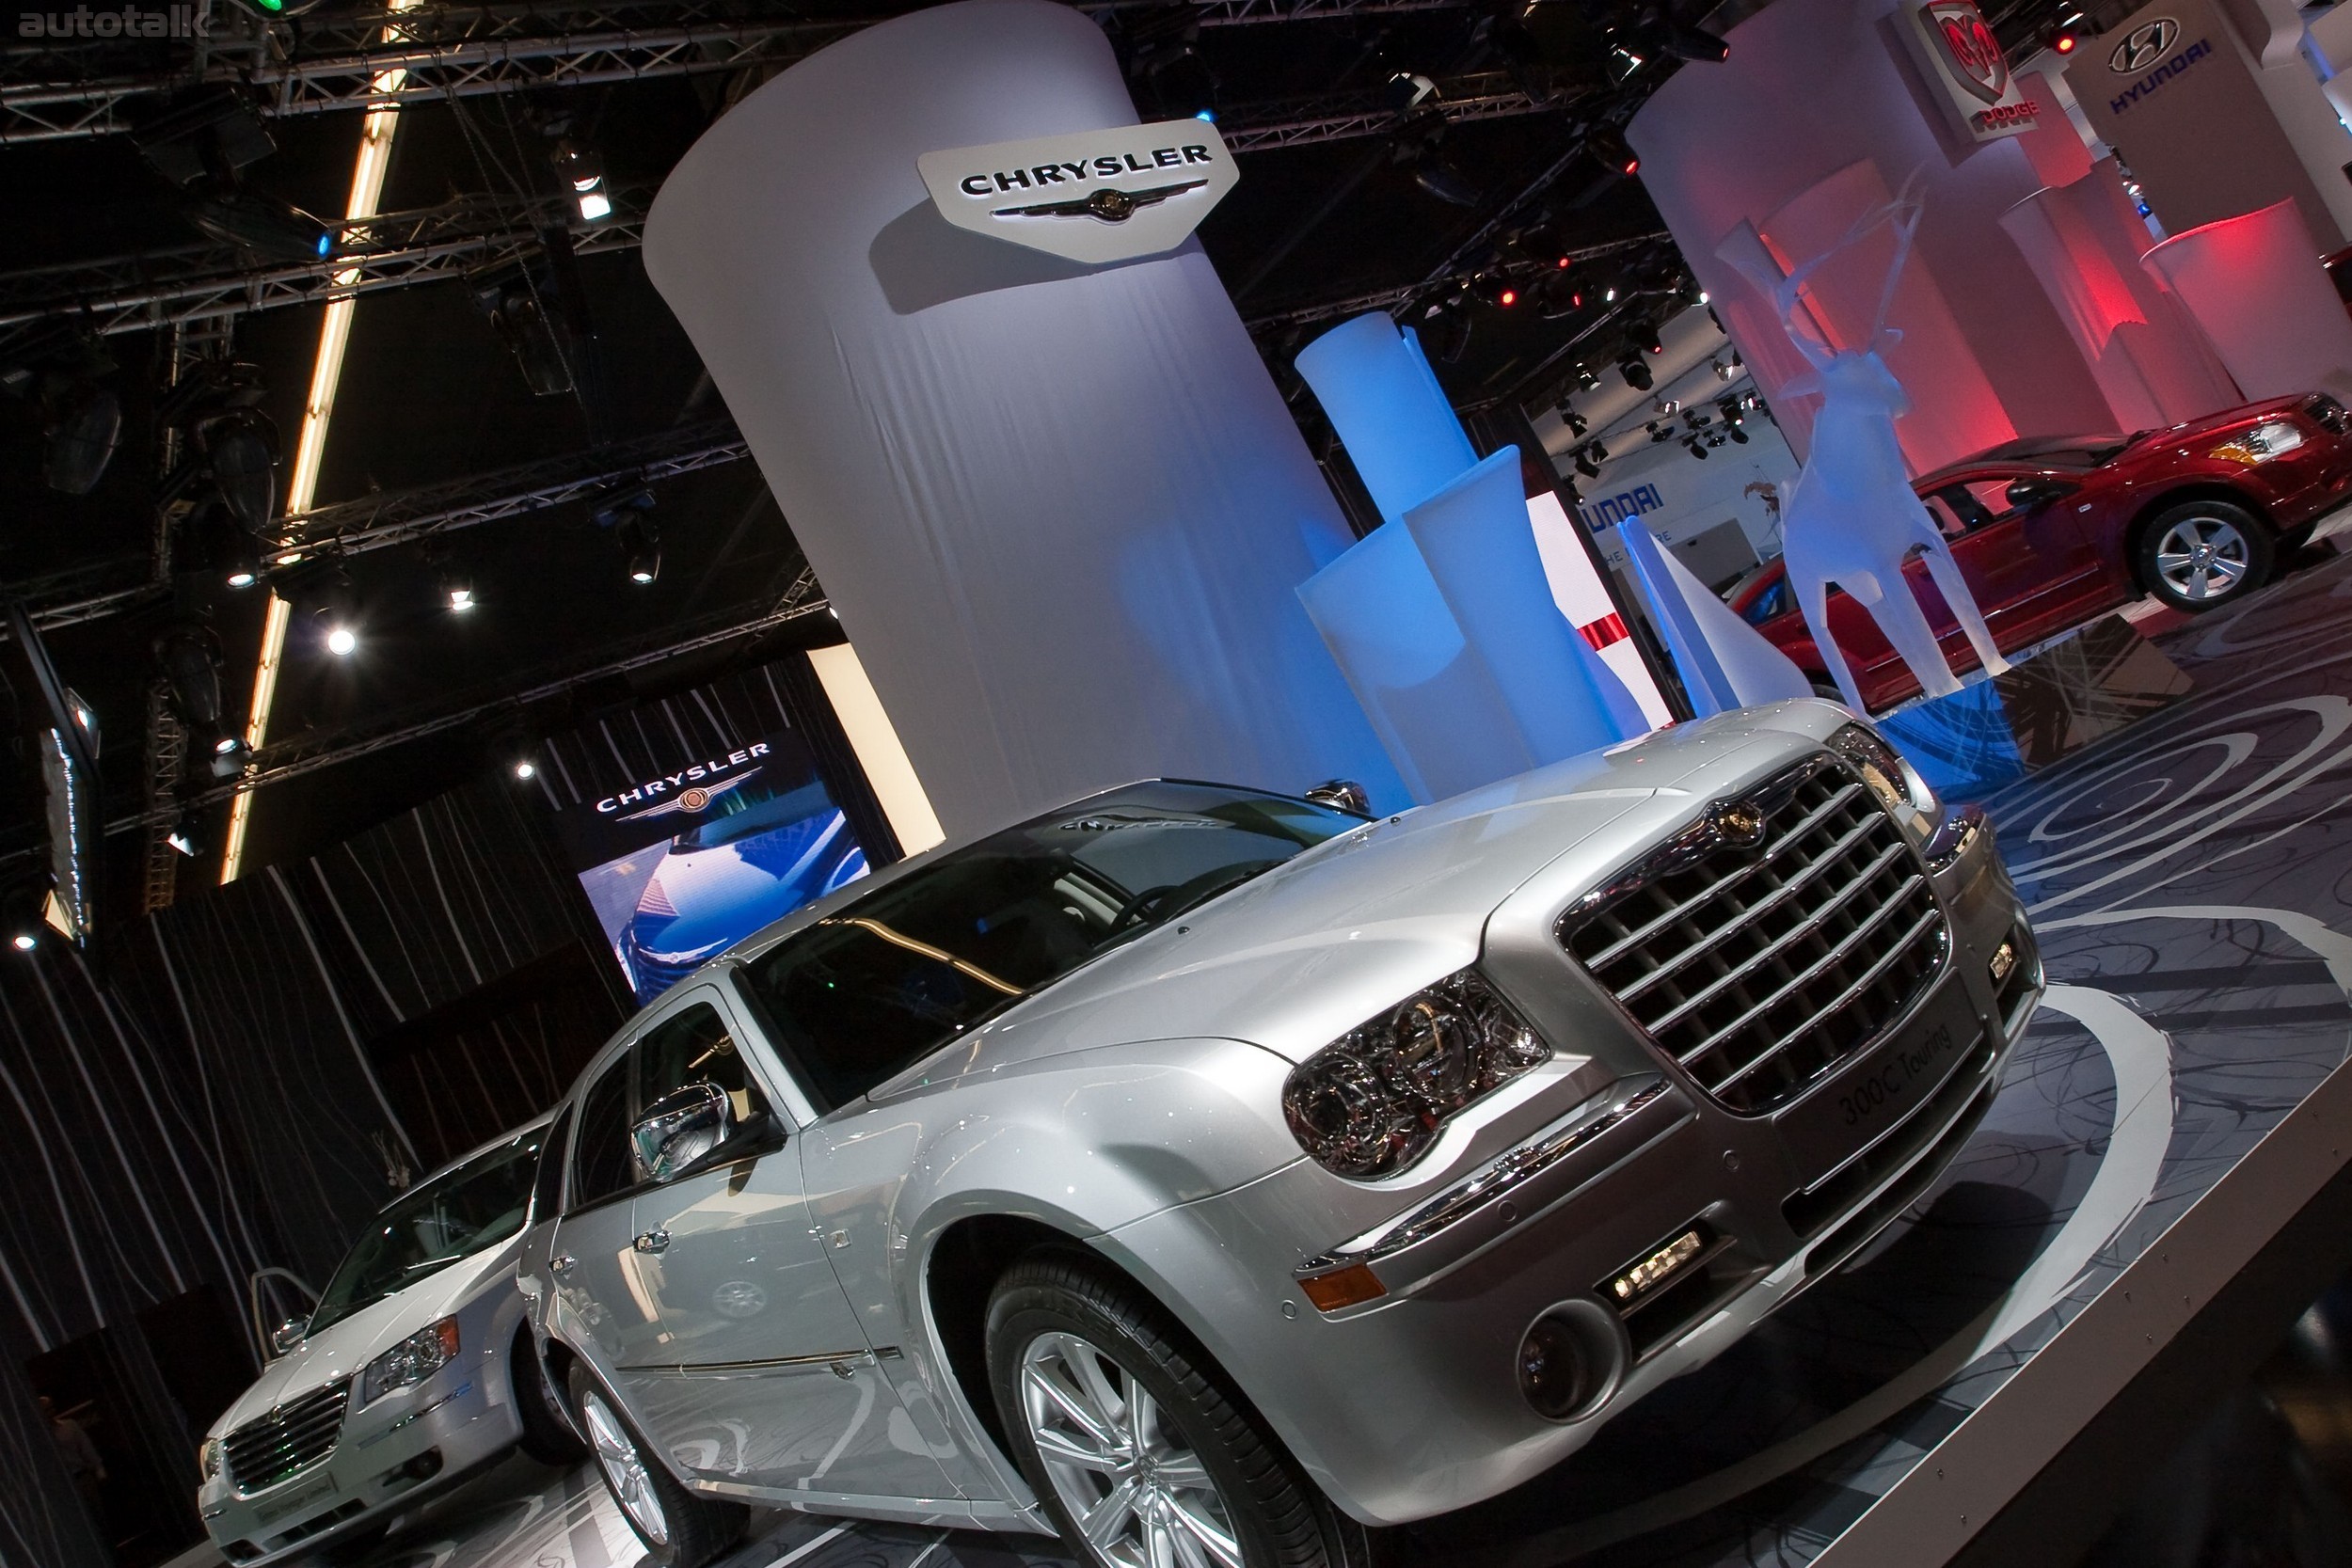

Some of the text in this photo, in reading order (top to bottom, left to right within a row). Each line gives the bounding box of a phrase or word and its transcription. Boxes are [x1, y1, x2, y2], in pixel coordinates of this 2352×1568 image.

[1982, 100, 2040, 124] DODGE
[2110, 39, 2211, 114] HYUNDAI
[961, 145, 1213, 197] CHRYSLER
[596, 742, 771, 813] CHRYSLER
[1839, 1023, 1952, 1126] 300C Touring
